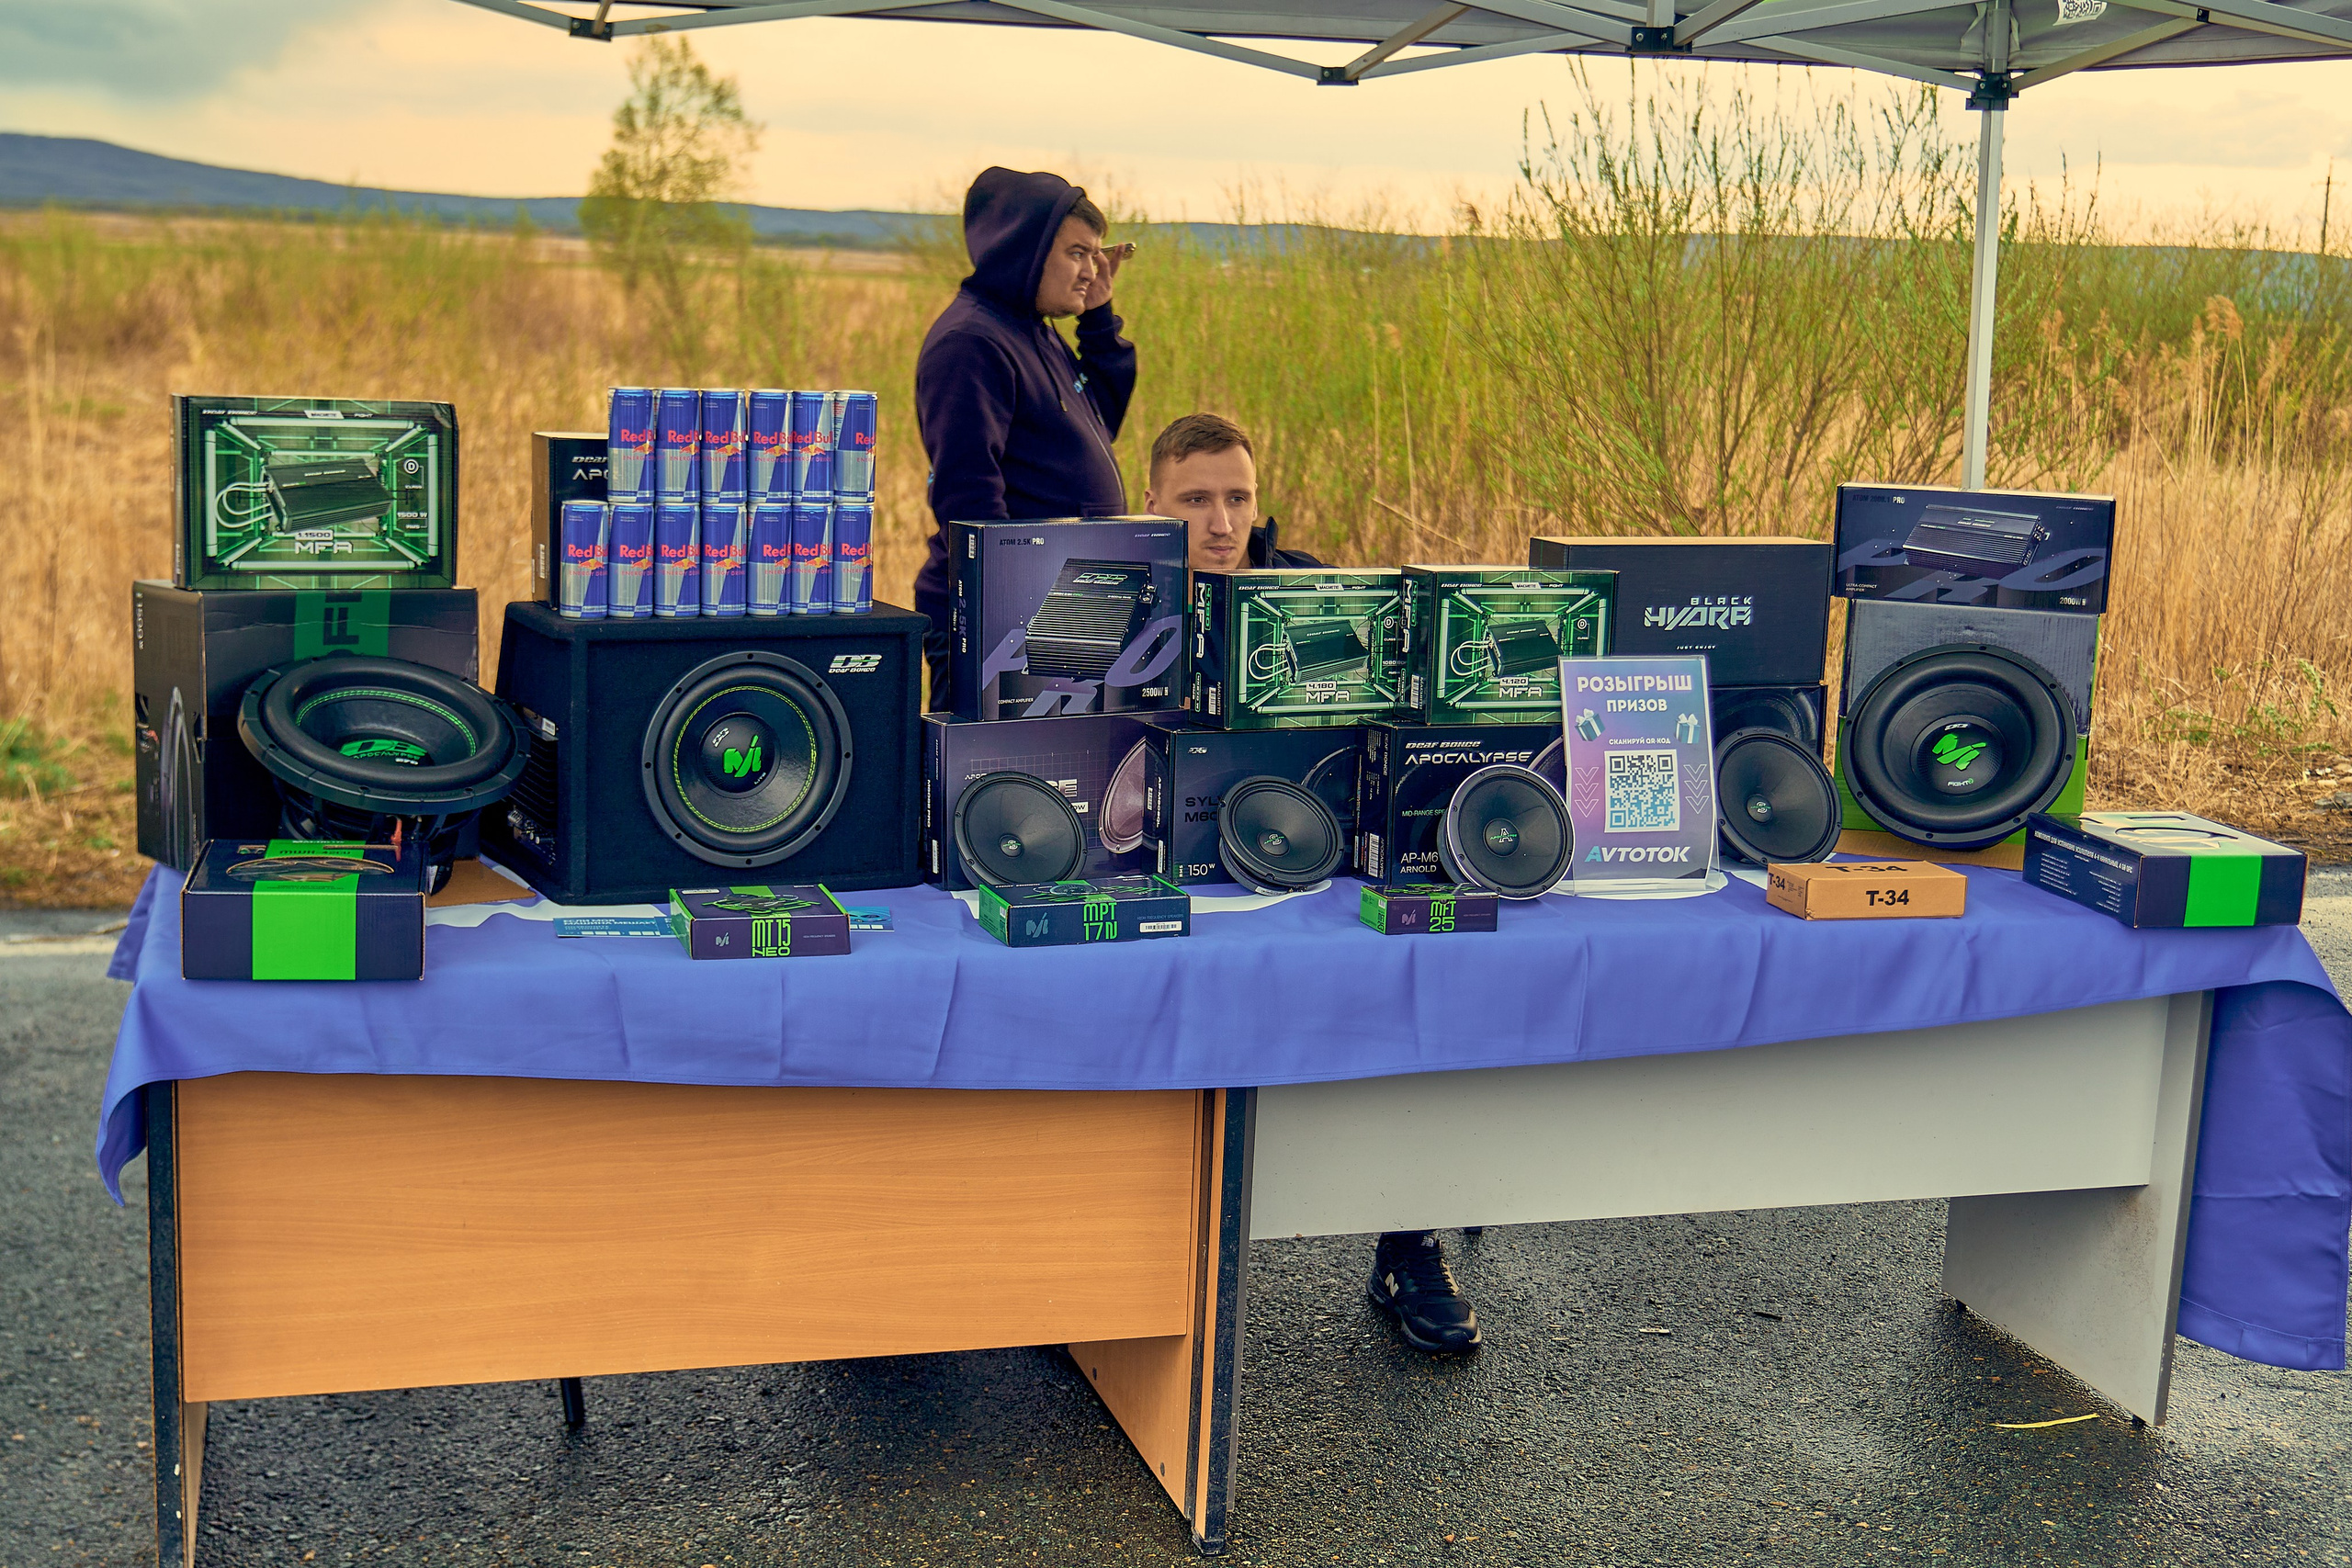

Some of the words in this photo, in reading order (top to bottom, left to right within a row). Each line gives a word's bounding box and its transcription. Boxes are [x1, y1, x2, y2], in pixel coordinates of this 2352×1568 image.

[621, 429, 646, 442] Red
[668, 430, 692, 443] Red
[706, 431, 729, 444] Red
[753, 431, 777, 444] Red
[792, 431, 812, 443] Red
[815, 431, 832, 444] Bull
[1893, 496, 1905, 504] PRO
[295, 541, 354, 554] MFA
[1032, 537, 1045, 546] PRO
[568, 544, 593, 558] Red
[620, 545, 645, 558] Red
[662, 545, 685, 558] Red
[705, 544, 728, 558] Red
[763, 545, 786, 557] Red
[795, 543, 818, 557] Red
[842, 543, 865, 556] Red
[1690, 597, 1752, 605] BLACK
[1195, 582, 1205, 659] MFA
[1402, 579, 1412, 653] MFA
[1645, 606, 1751, 631] HYDRA
[1577, 675, 1692, 693] РОЗЫГРЫШ
[1142, 687, 1163, 697] 2500W
[1306, 691, 1350, 704] MFA
[1499, 687, 1543, 698] MFA
[1607, 698, 1668, 712] ПРИЗОВ
[1405, 751, 1532, 765] APOCALYPSE
[1584, 845, 1690, 863] AVTOTOK
[1188, 863, 1208, 876] 150
[1400, 865, 1437, 874] ARNOLD
[1769, 873, 1786, 890] T-34
[1866, 889, 1909, 906] T-34
[1083, 902, 1117, 921] MPT
[1430, 901, 1456, 916] MFT
[1429, 917, 1455, 932] 25
[752, 919, 774, 947] MT
[776, 919, 790, 947] 15
[1084, 922, 1117, 941] 17N
[752, 947, 791, 957] NEO
